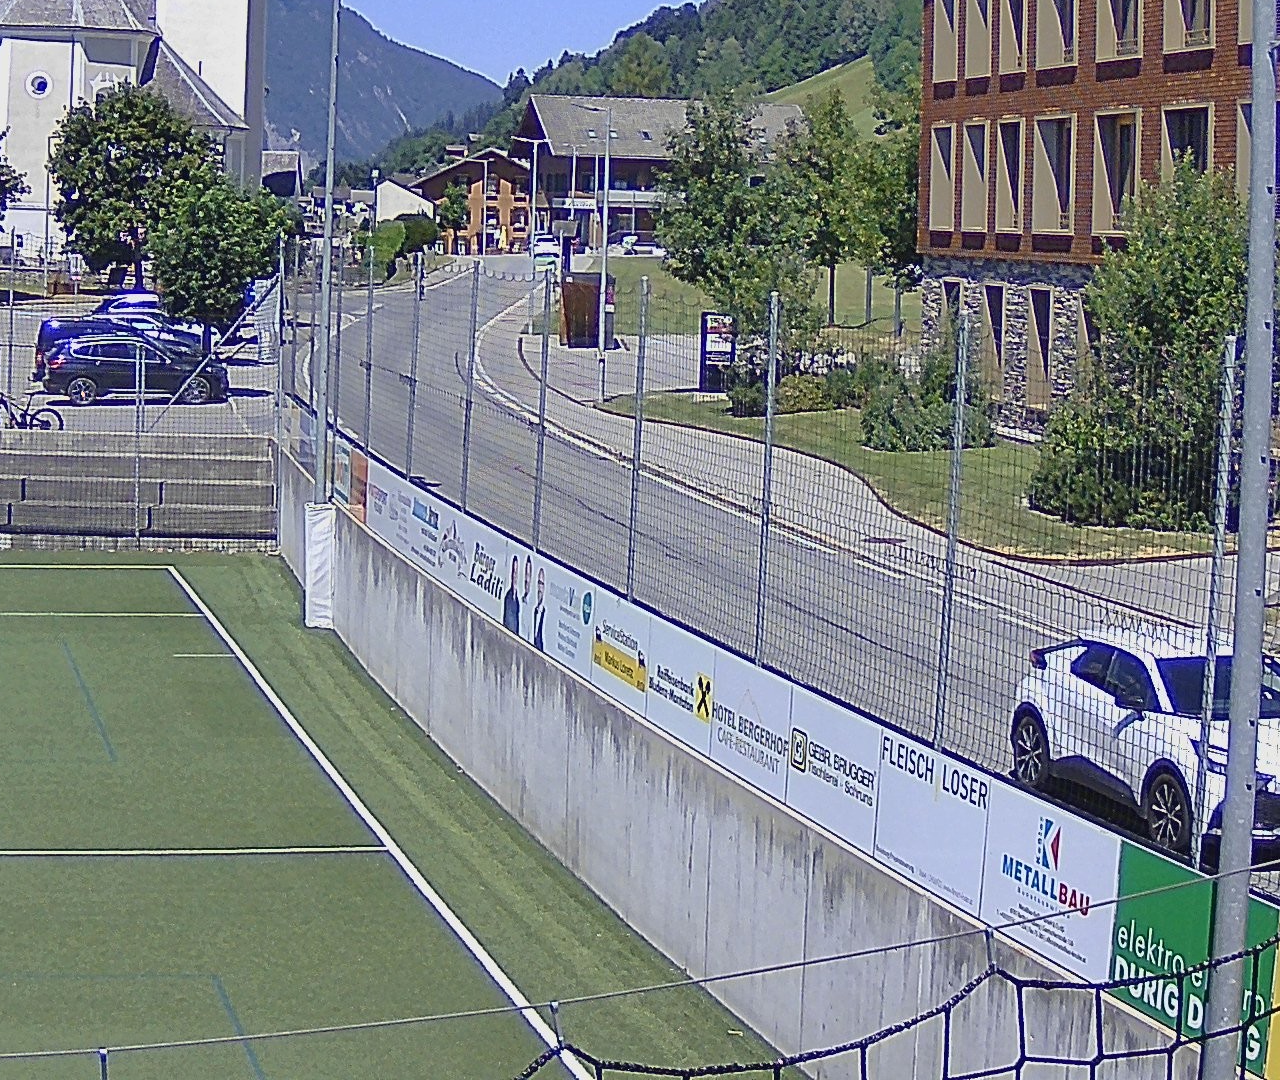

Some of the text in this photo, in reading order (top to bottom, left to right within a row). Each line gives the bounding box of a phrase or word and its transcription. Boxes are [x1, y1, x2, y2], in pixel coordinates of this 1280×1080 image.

[656, 664, 694, 697] Raiffeisenbank
[712, 701, 737, 731] HOTEL
[738, 715, 790, 757] BERGERHOF
[808, 740, 832, 768] GEBR.
[833, 753, 875, 790] BRUGGER
[808, 759, 839, 788] Tischlerei
[844, 780, 874, 807] Schruns
[882, 735, 989, 810] FLEISCH LOSER
[1002, 854, 1090, 916] METALLBAU
[1117, 919, 1185, 975] elektro
[1114, 955, 1180, 1018] DURIG
